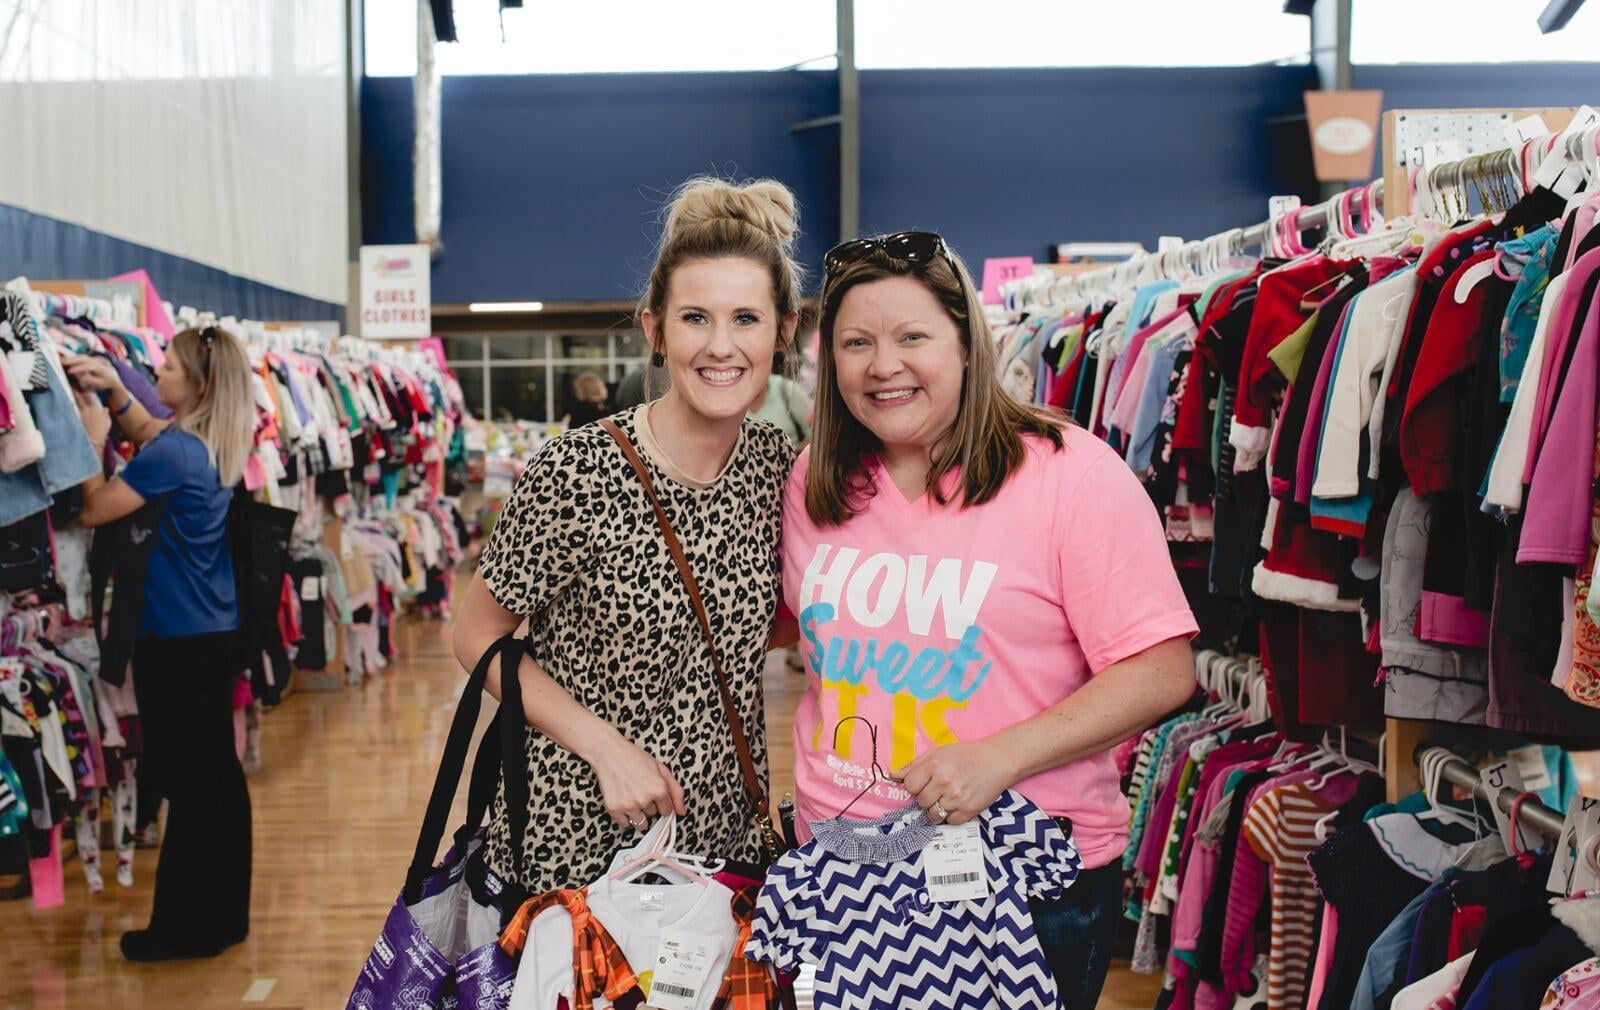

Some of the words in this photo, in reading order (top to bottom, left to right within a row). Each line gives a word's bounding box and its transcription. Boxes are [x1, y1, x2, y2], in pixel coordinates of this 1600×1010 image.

[374, 290, 416, 304] GIRLS
[365, 308, 427, 324] CLOTHES
[800, 543, 999, 641] HOW
[799, 602, 992, 702] Sweet
[832, 772, 854, 789] April
[856, 781, 863, 791] 5
[1489, 763, 1507, 788] J
